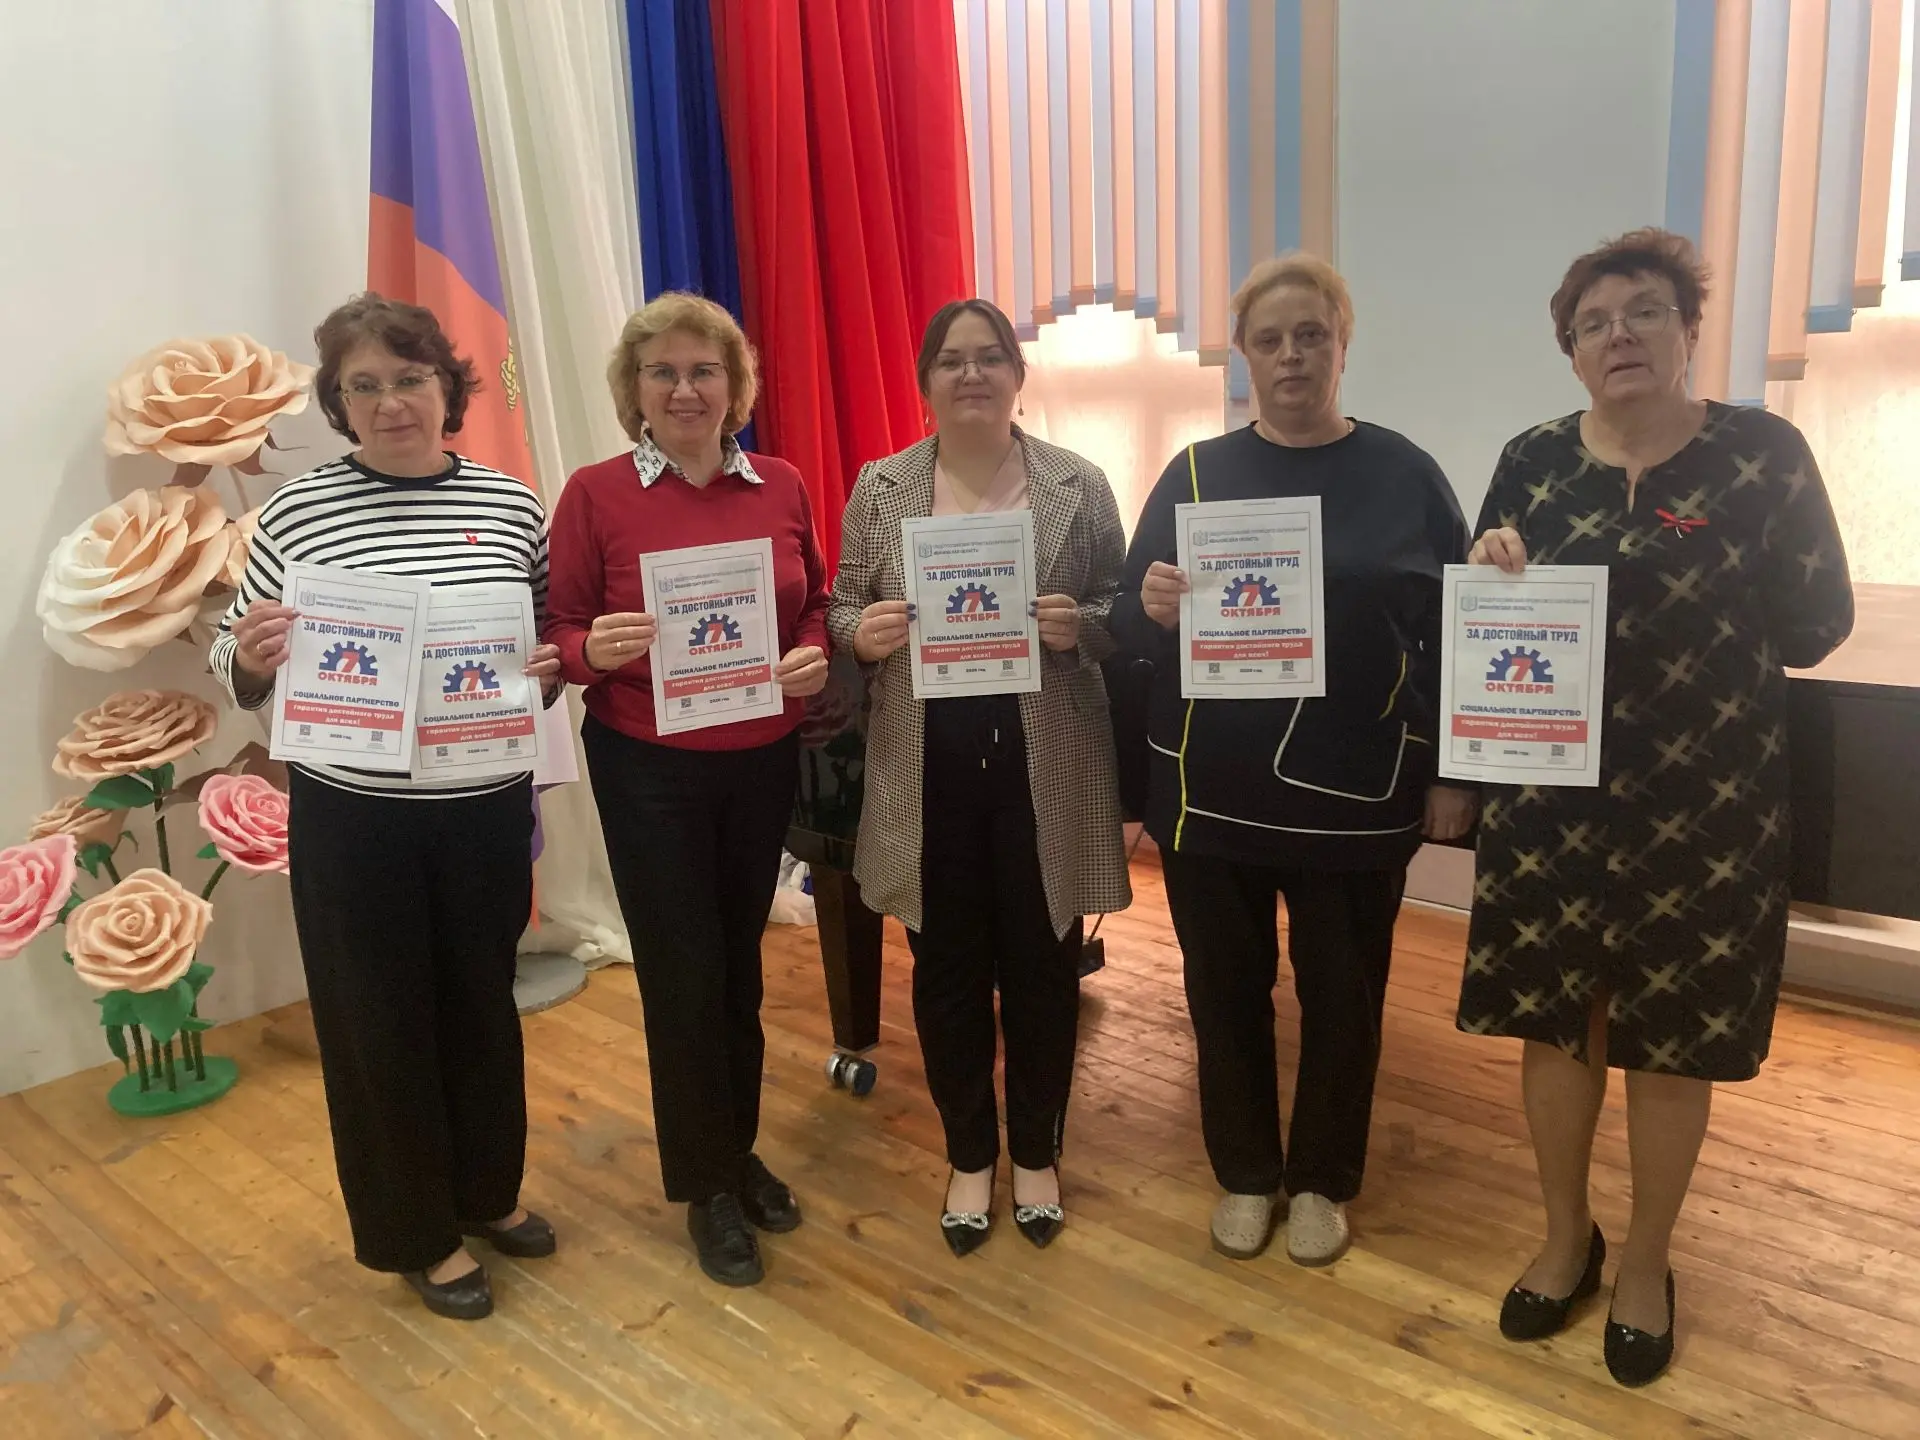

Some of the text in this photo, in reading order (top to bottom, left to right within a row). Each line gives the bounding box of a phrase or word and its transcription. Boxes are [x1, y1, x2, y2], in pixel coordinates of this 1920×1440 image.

[1201, 557, 1299, 571] ЗА ДОСТОЙНЫЙ ТРУД
[926, 566, 1015, 581] ЗА ДОСТОЙНЫЙ ТРУД
[965, 592, 981, 612] 7
[1242, 584, 1260, 606] 7
[668, 595, 756, 615] ЗА ДОСТОЙНЫЙ ТРУД
[1221, 607, 1280, 617] ОКТЯБРЯ
[946, 612, 1000, 623] ОКТЯБРЯ
[304, 621, 401, 643] ЗА ДОСТОЙНЫЙ ТРУД
[708, 624, 724, 643] 7
[975, 631, 1023, 639] ПАРТНЕРСТВО
[1251, 628, 1306, 636] ПАРТНЕРСТВО
[1467, 628, 1578, 643] ЗА ДОСТОЙНЫЙ ТРУД
[422, 644, 515, 659] ЗА ДОСТОЙНЫЙ ТРУД
[689, 641, 742, 655] ОКТЯБРЯ
[342, 652, 360, 673] 7
[670, 657, 764, 676] СОЦИАЛЬНОЕ ПАРТНЕРСТВО
[1511, 657, 1532, 681] 7
[318, 673, 377, 685] ОКТЯБРЯ
[463, 670, 480, 692] 7
[1485, 683, 1553, 693] ОКТЯБРЯ
[294, 691, 399, 707] СОЦИАЛЬНОЕ ПАРТНЕРСТВО
[444, 690, 501, 703] ОКТЯБРЯ
[424, 707, 527, 723] СОЦИАЛЬНОЕ ПАРТНЕРСТВО
[1461, 705, 1581, 716] СОЦИАЛЬНОЕ ПАРТНЕРСТВО
